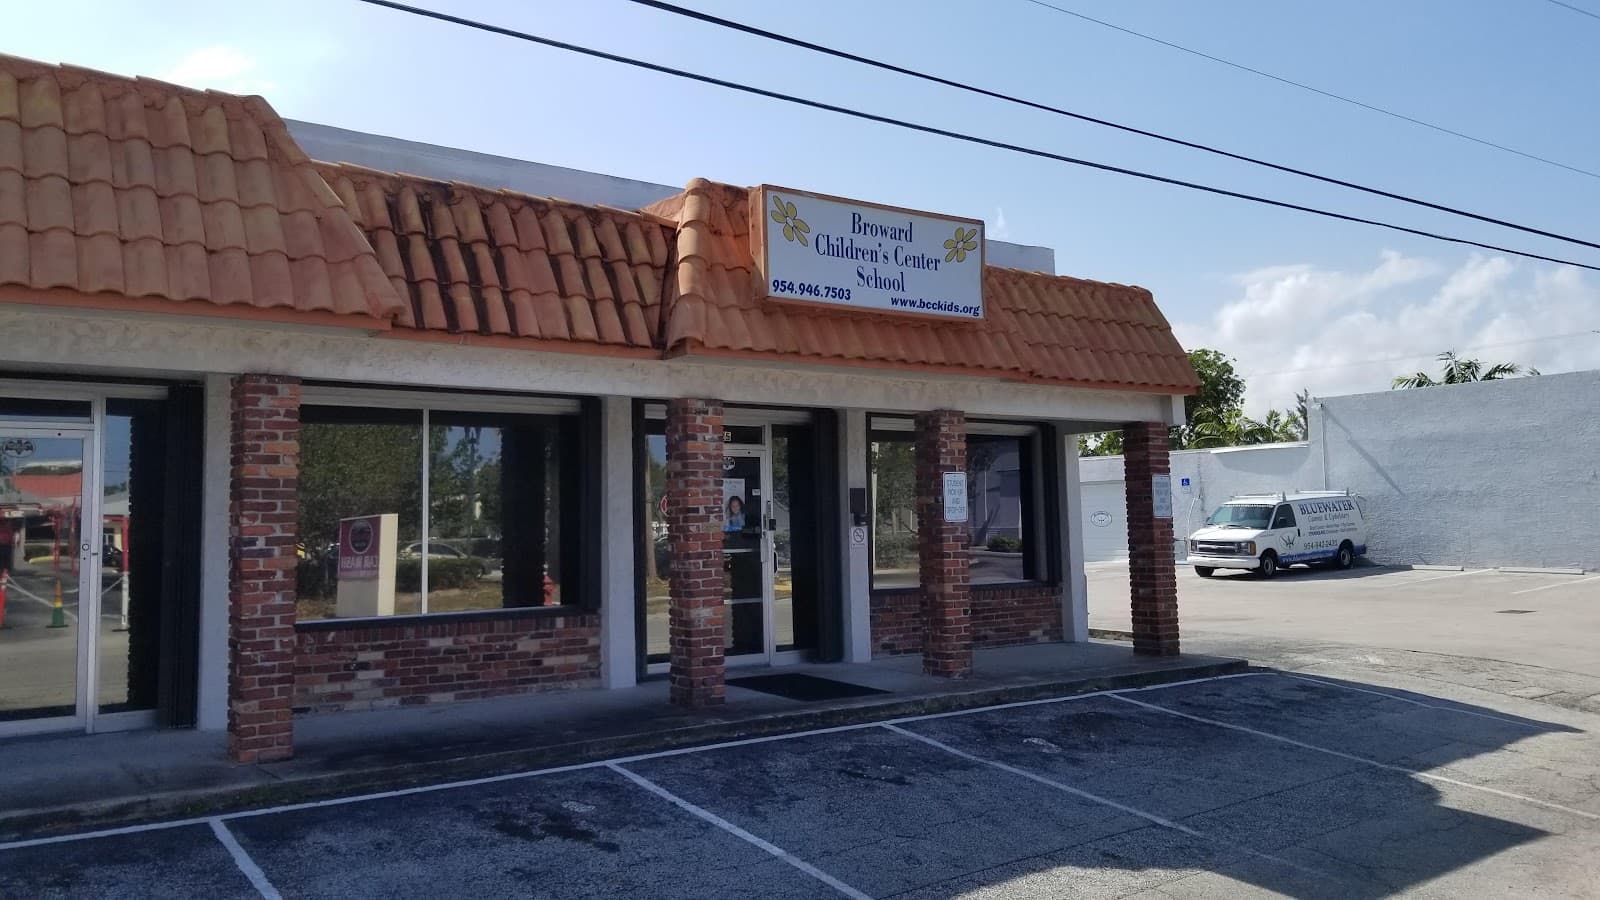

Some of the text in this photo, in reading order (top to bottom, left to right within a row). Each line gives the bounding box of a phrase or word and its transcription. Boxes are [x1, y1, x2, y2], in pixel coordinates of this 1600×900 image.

[851, 212, 913, 243] Broward
[815, 233, 941, 271] Children's Center
[772, 279, 851, 300] 954.946.7503
[856, 265, 905, 292] School
[890, 296, 981, 317] www.bcckids.org
[1298, 500, 1355, 515] BLUEWATER
